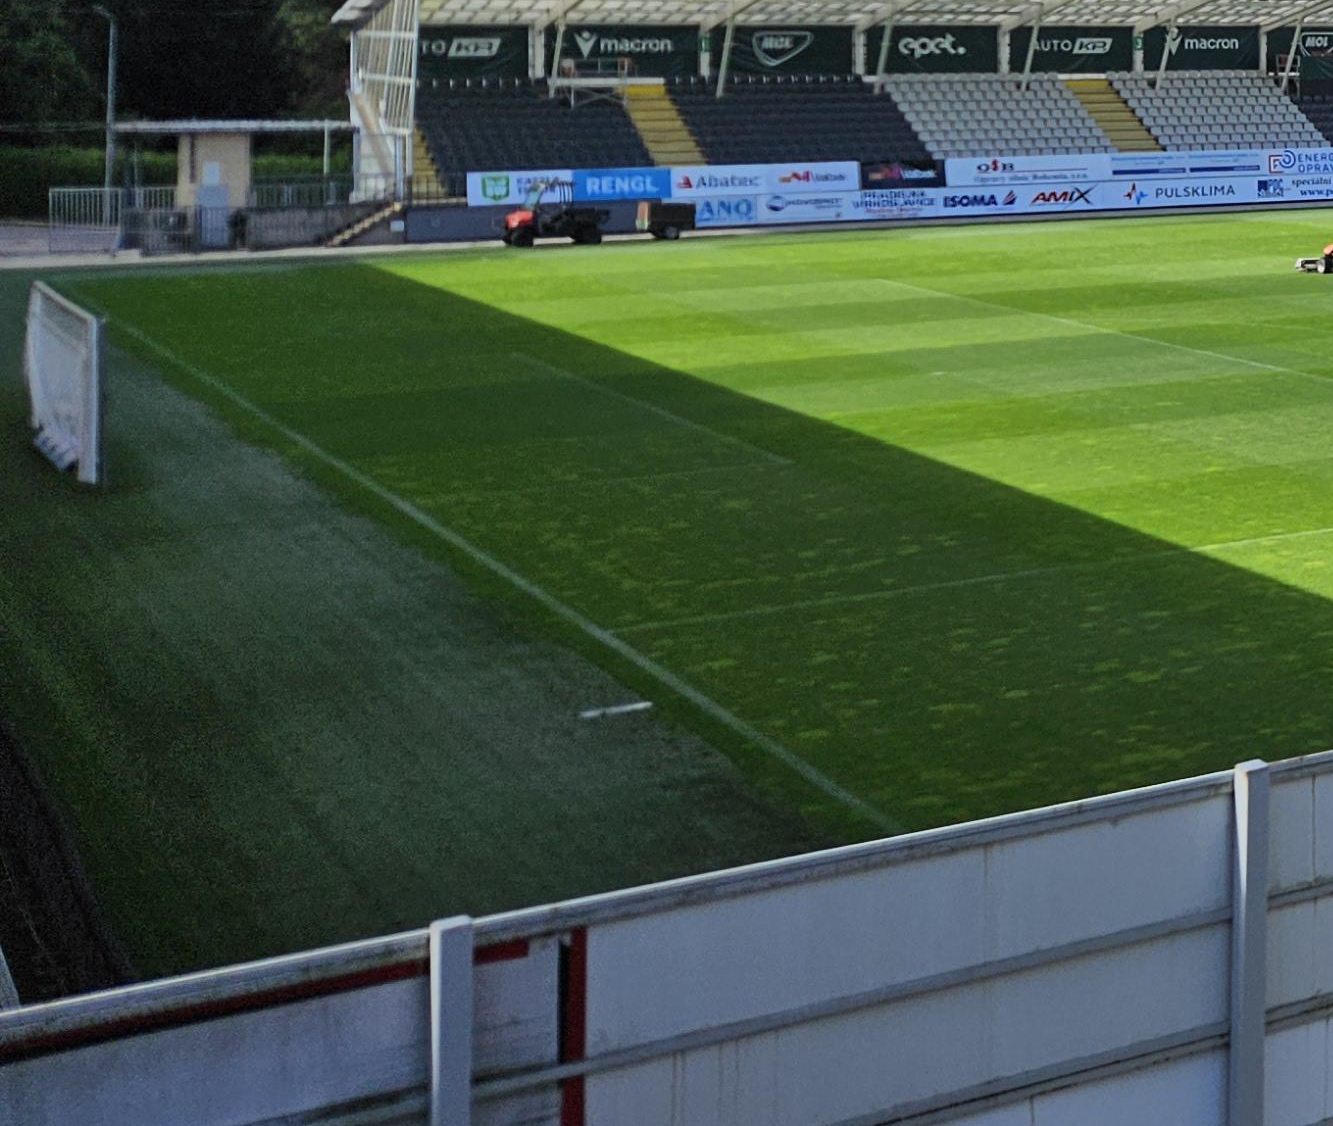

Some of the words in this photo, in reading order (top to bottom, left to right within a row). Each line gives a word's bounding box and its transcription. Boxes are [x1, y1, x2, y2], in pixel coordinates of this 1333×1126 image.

[422, 39, 446, 56] TO
[601, 37, 671, 52] macron
[1033, 39, 1072, 52] AUTO
[1184, 36, 1239, 50] macron
[1305, 35, 1329, 47] MOL
[586, 175, 660, 195] RENGL
[696, 175, 760, 189] Abatec
[1030, 184, 1099, 208] AMIX
[1155, 185, 1236, 199] PULSKLIMA
[943, 194, 998, 208] ISOMA
[699, 199, 752, 220] ANO
